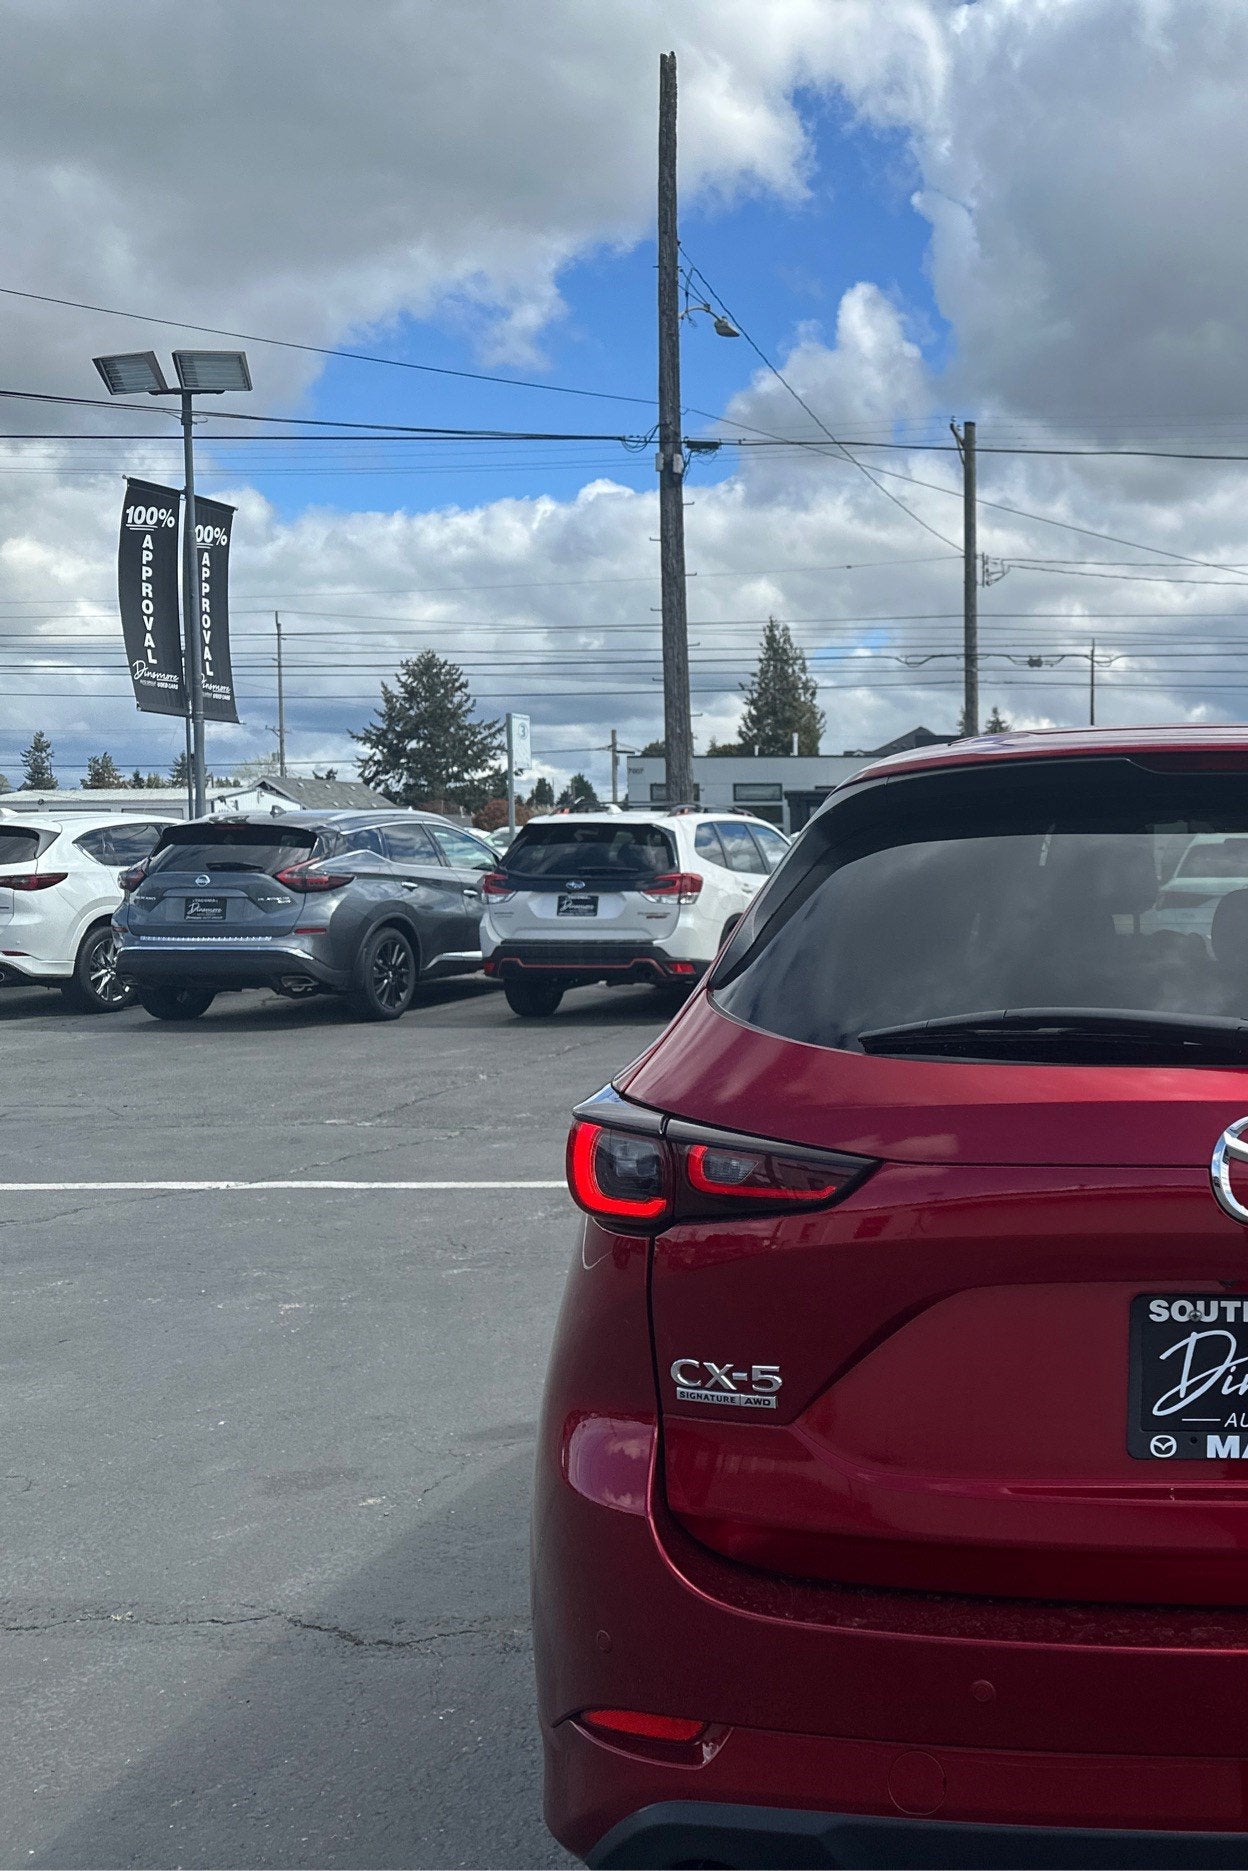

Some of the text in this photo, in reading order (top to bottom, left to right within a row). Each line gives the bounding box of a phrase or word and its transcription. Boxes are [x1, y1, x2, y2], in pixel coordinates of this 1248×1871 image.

[126, 505, 175, 528] 100%
[195, 524, 228, 546] 00%
[141, 534, 157, 665] APPROVAL
[201, 552, 214, 676] APPROVAL
[132, 660, 180, 682] Dinsmore
[670, 1358, 783, 1393] CX-5
[679, 1391, 771, 1407] SIGNATURE AWD
